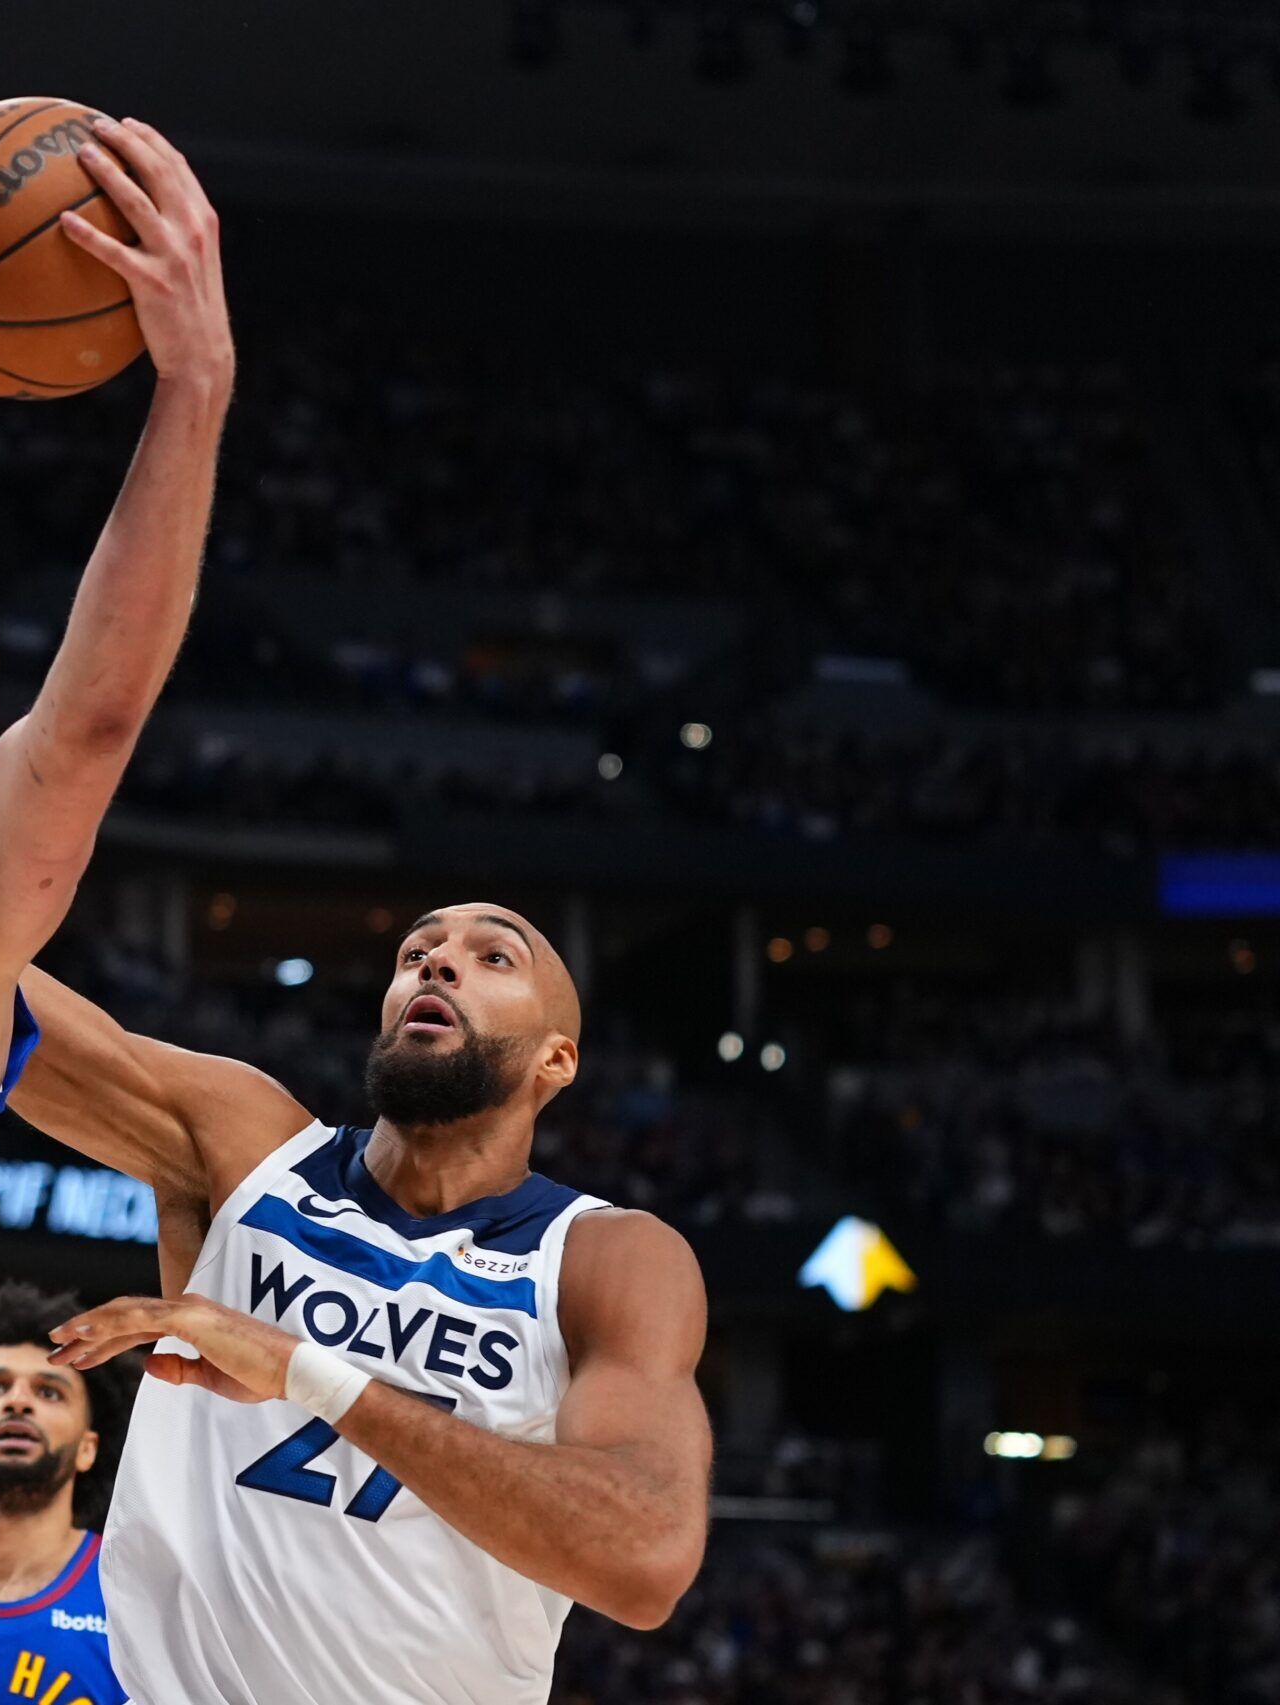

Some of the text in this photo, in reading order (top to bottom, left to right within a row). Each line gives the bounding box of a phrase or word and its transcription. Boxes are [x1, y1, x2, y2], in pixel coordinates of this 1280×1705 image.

[463, 1252, 529, 1274] sezzle
[250, 1252, 520, 1391] WOLVES
[51, 1608, 108, 1634] ibott
